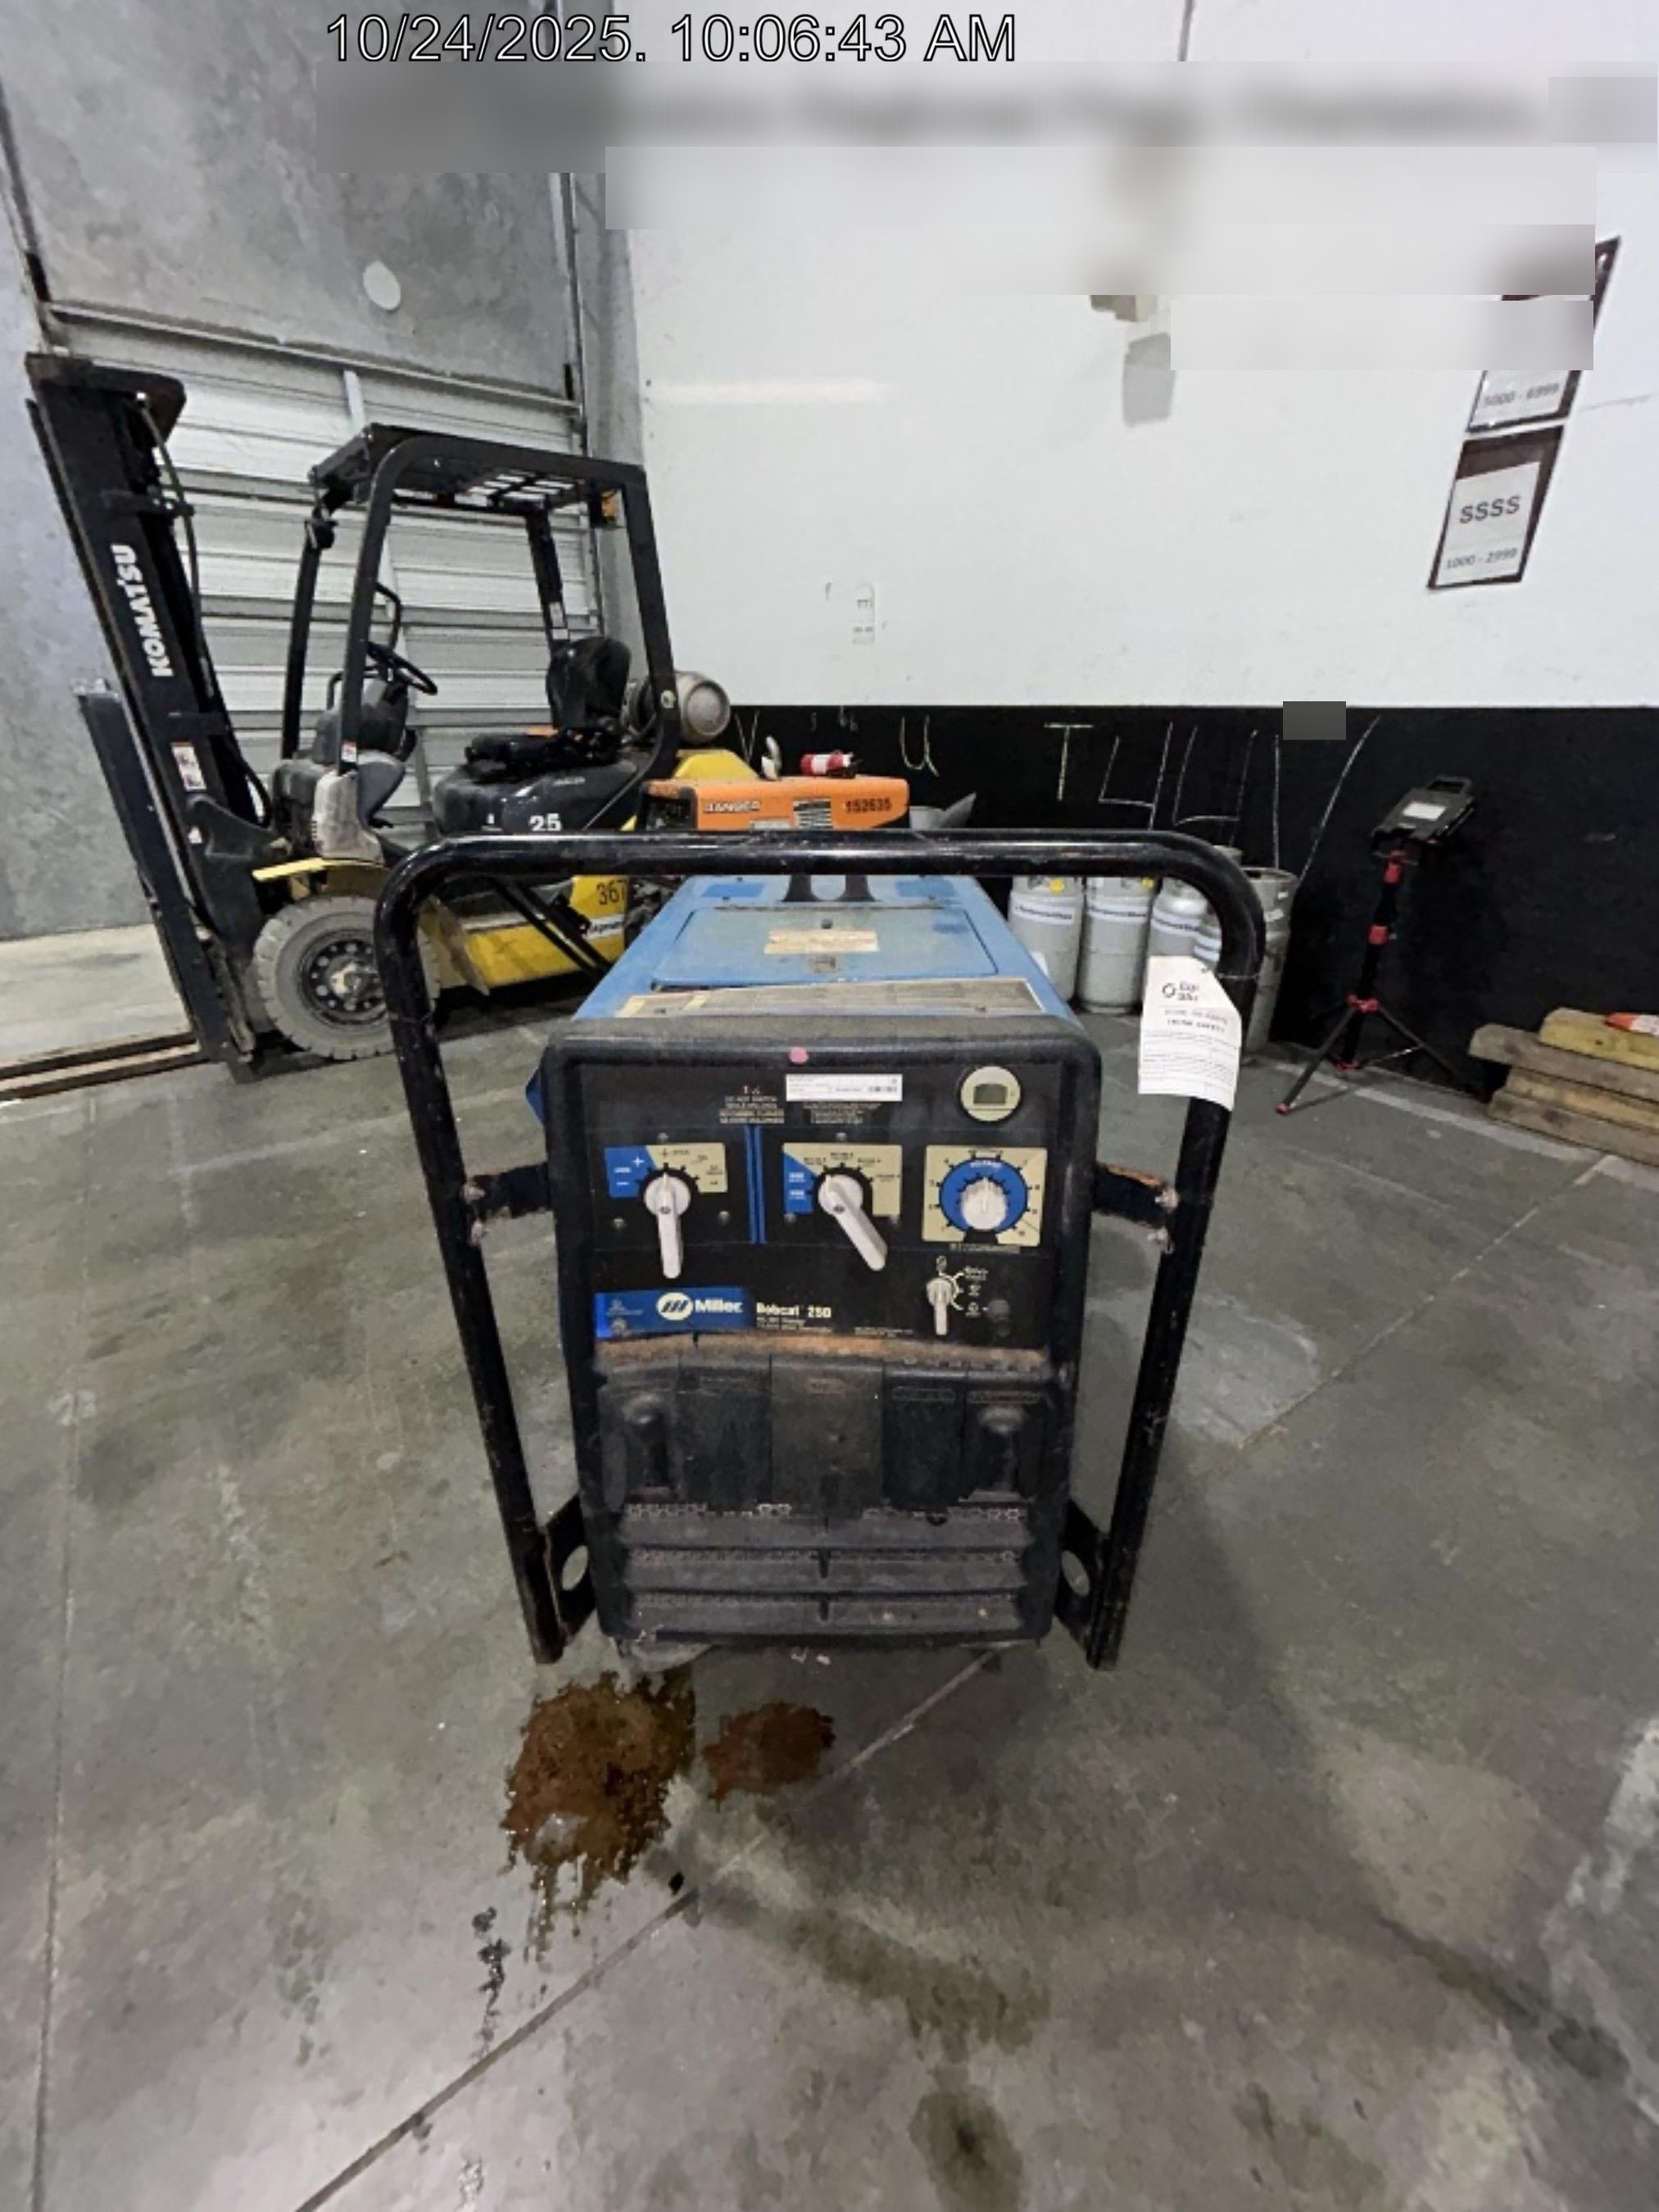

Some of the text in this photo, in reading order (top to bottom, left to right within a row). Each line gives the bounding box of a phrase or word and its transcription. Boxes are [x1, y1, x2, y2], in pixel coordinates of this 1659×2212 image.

[1459, 495, 1521, 524] SSSS
[111, 544, 175, 678] KOMATSU
[530, 812, 562, 832] 25
[755, 1302, 832, 1318] Bobcat 250
